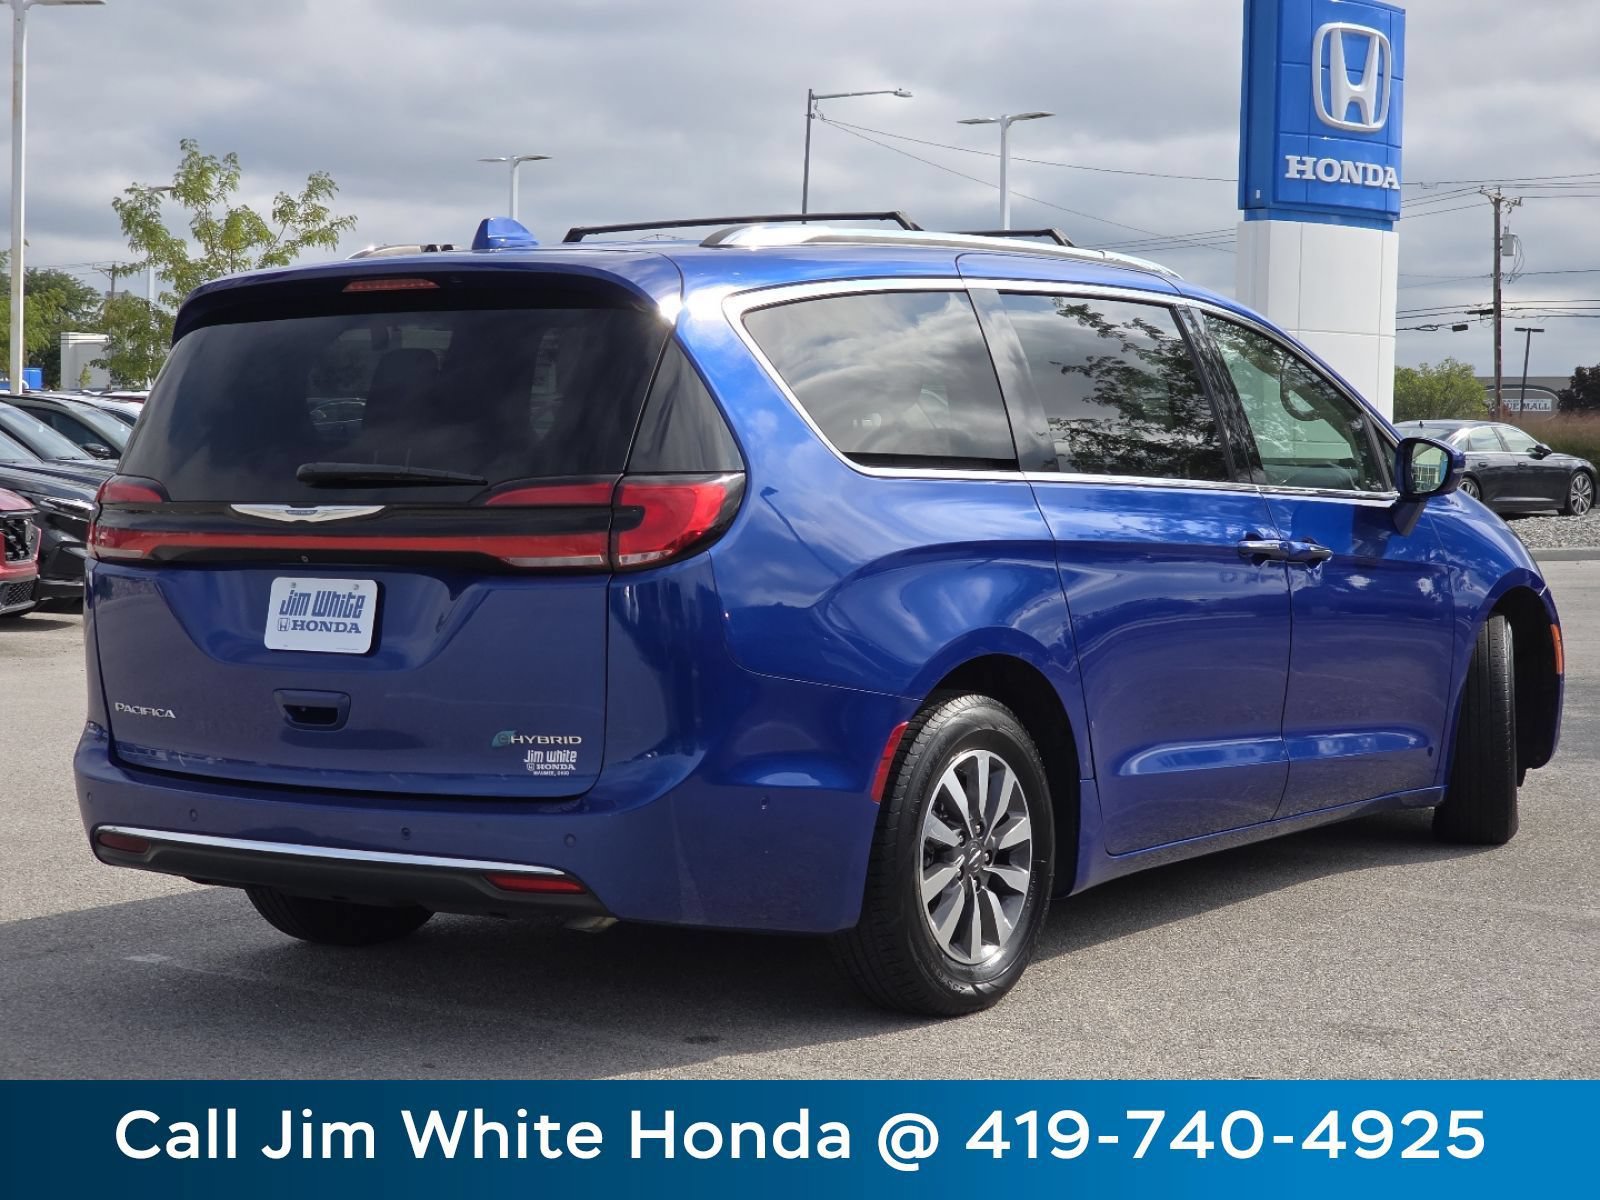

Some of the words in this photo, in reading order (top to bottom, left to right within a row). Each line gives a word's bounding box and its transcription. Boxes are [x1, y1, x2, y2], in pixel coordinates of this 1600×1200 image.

[1284, 155, 1401, 190] HONDA
[279, 590, 312, 617] Jim
[311, 590, 366, 619] White
[291, 619, 362, 634] HONDA
[114, 702, 177, 719] PACIFICA
[523, 749, 544, 763] Jim
